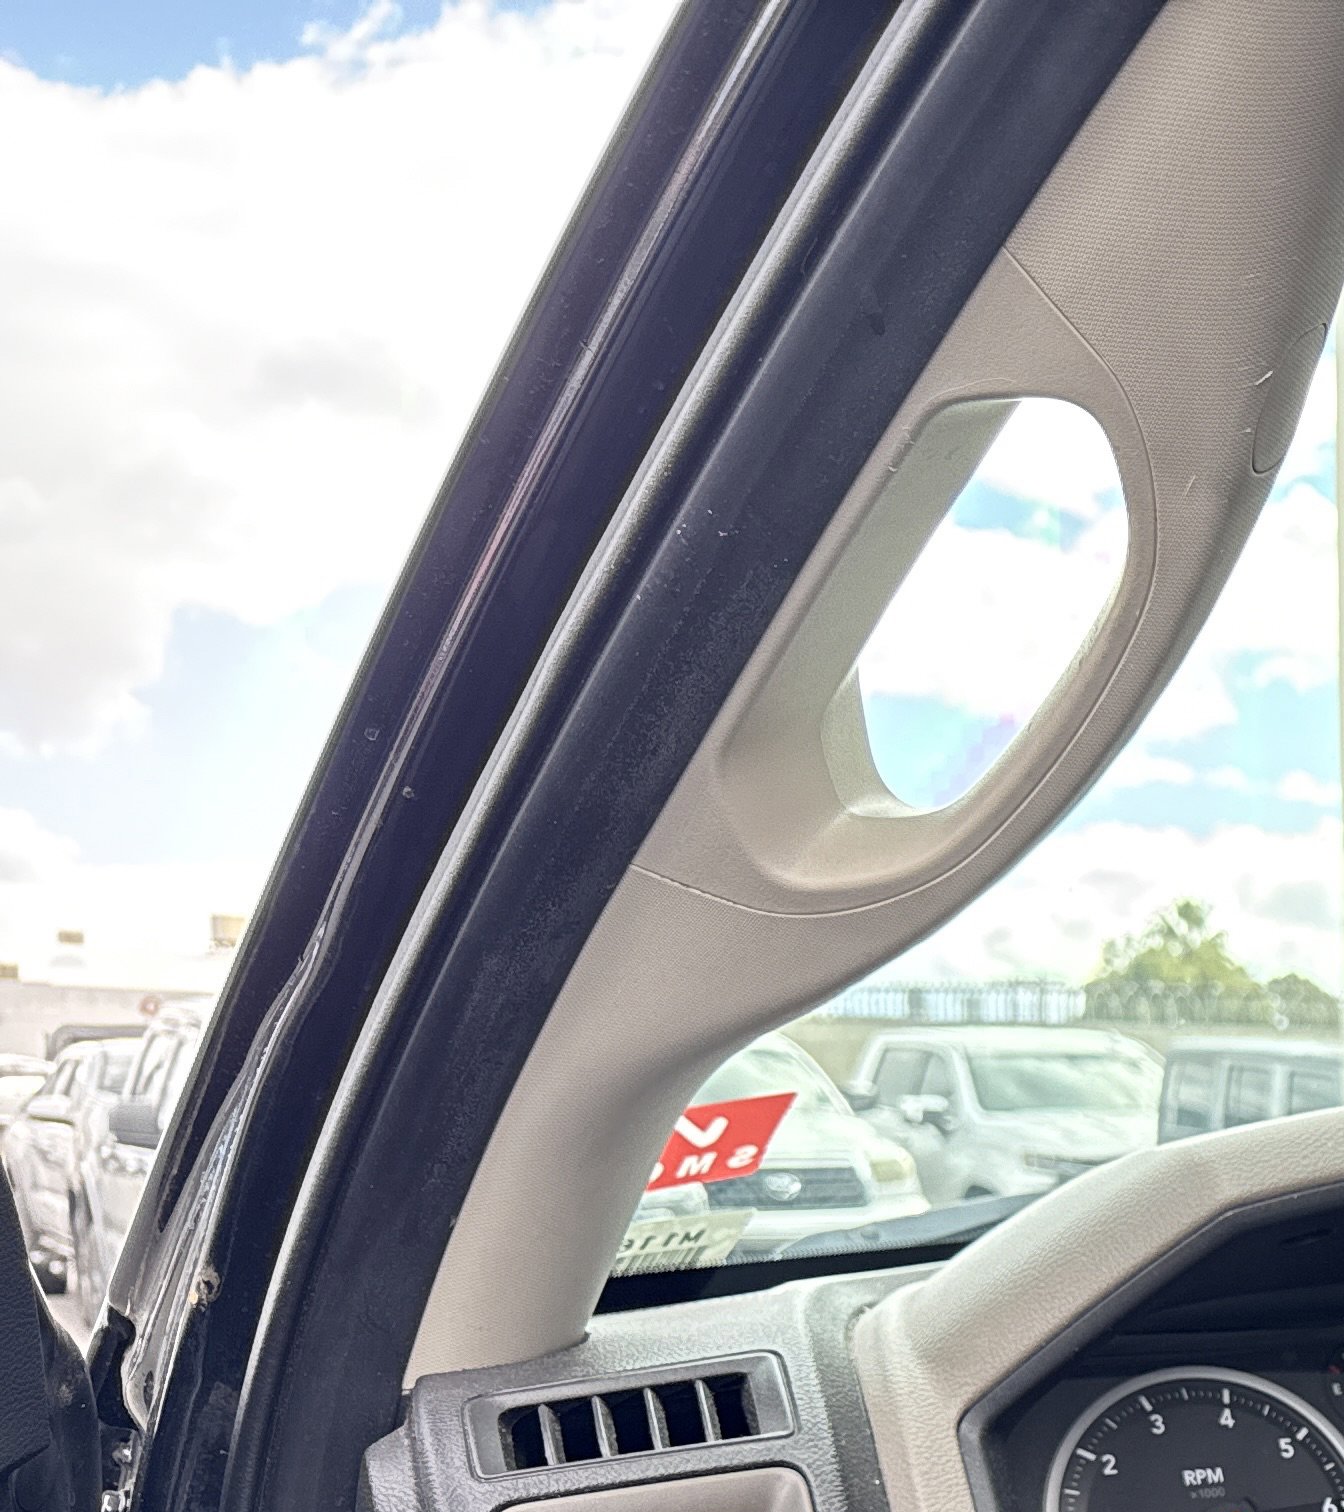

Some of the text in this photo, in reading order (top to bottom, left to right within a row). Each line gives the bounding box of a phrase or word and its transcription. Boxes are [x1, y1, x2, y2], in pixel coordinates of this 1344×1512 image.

[1150, 1415, 1165, 1435] 3
[1219, 1408, 1235, 1429] 4
[1279, 1438, 1294, 1459] 5
[1101, 1456, 1118, 1476] 2
[1182, 1466, 1225, 1487] RPM
